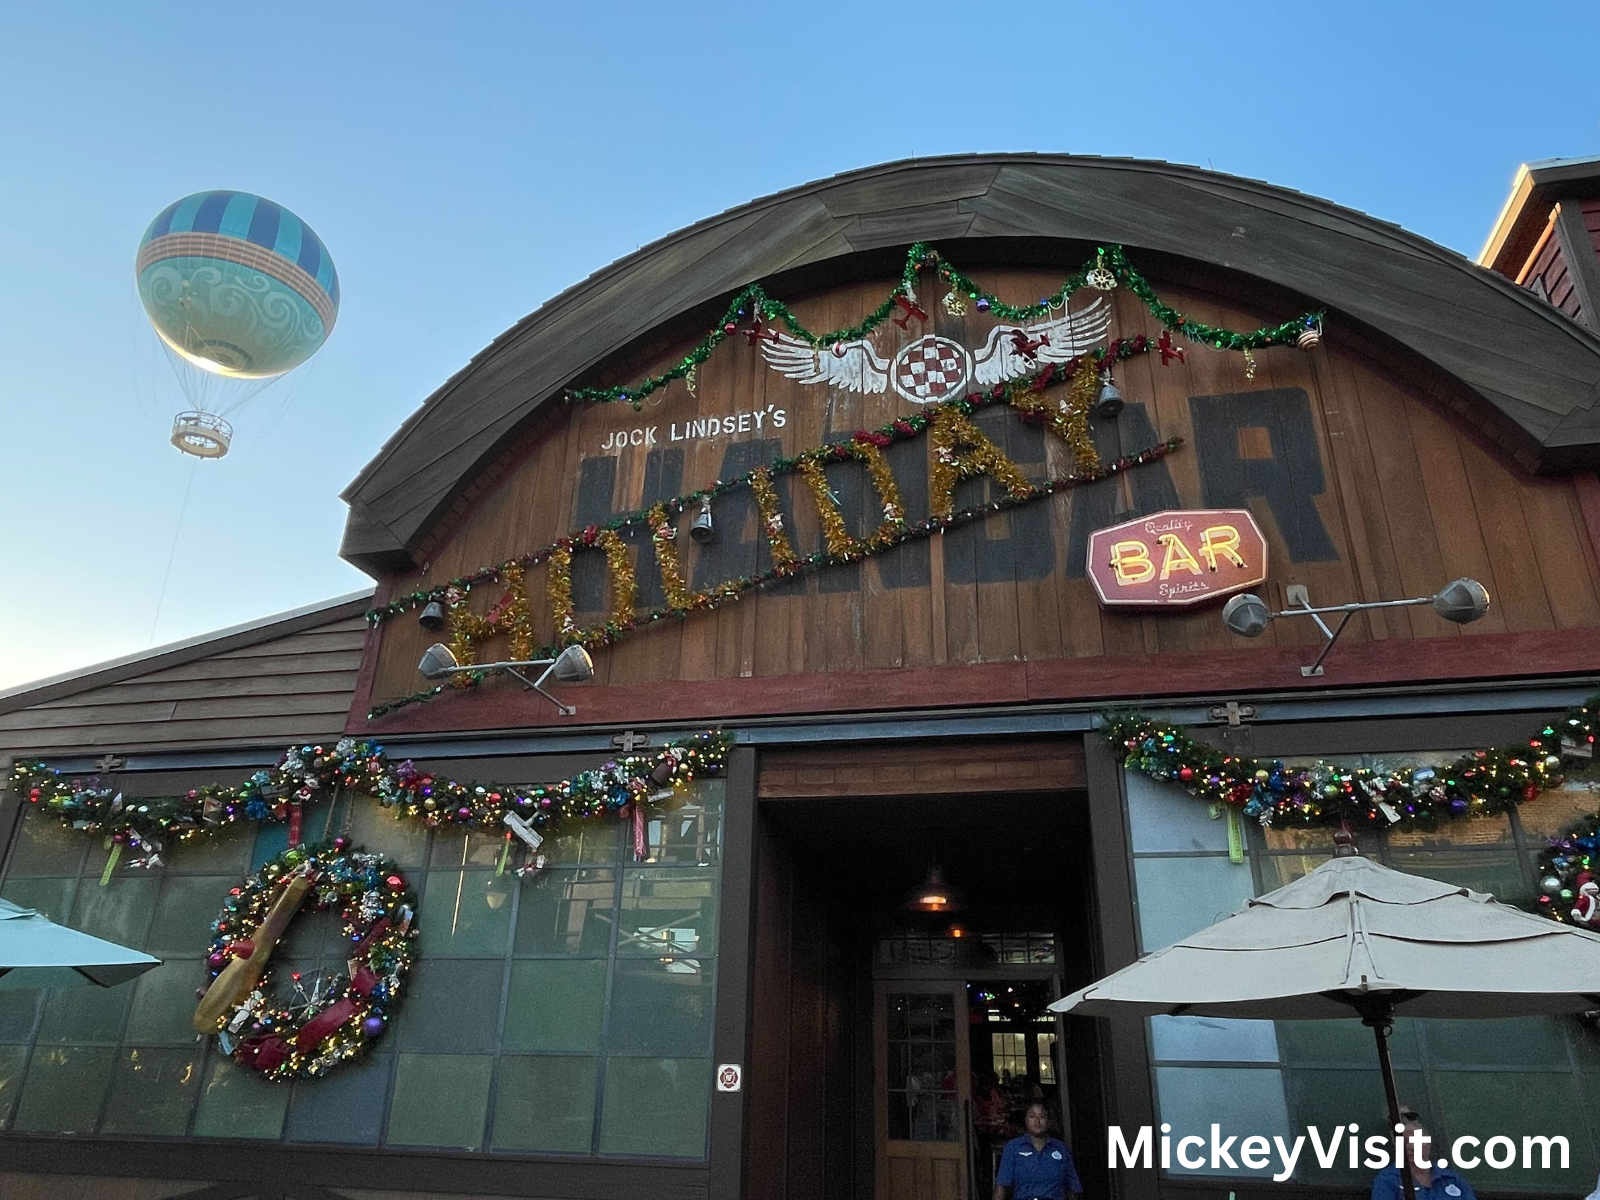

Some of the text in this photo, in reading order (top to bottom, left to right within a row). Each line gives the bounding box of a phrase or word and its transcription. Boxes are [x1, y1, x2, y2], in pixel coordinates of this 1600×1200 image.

[600, 404, 787, 450] JOCK LINDSEY'S
[449, 354, 1102, 688] HOLIDAY
[1144, 518, 1194, 535] Quality
[1109, 525, 1248, 587] BAR
[1159, 583, 1210, 599] Spirits
